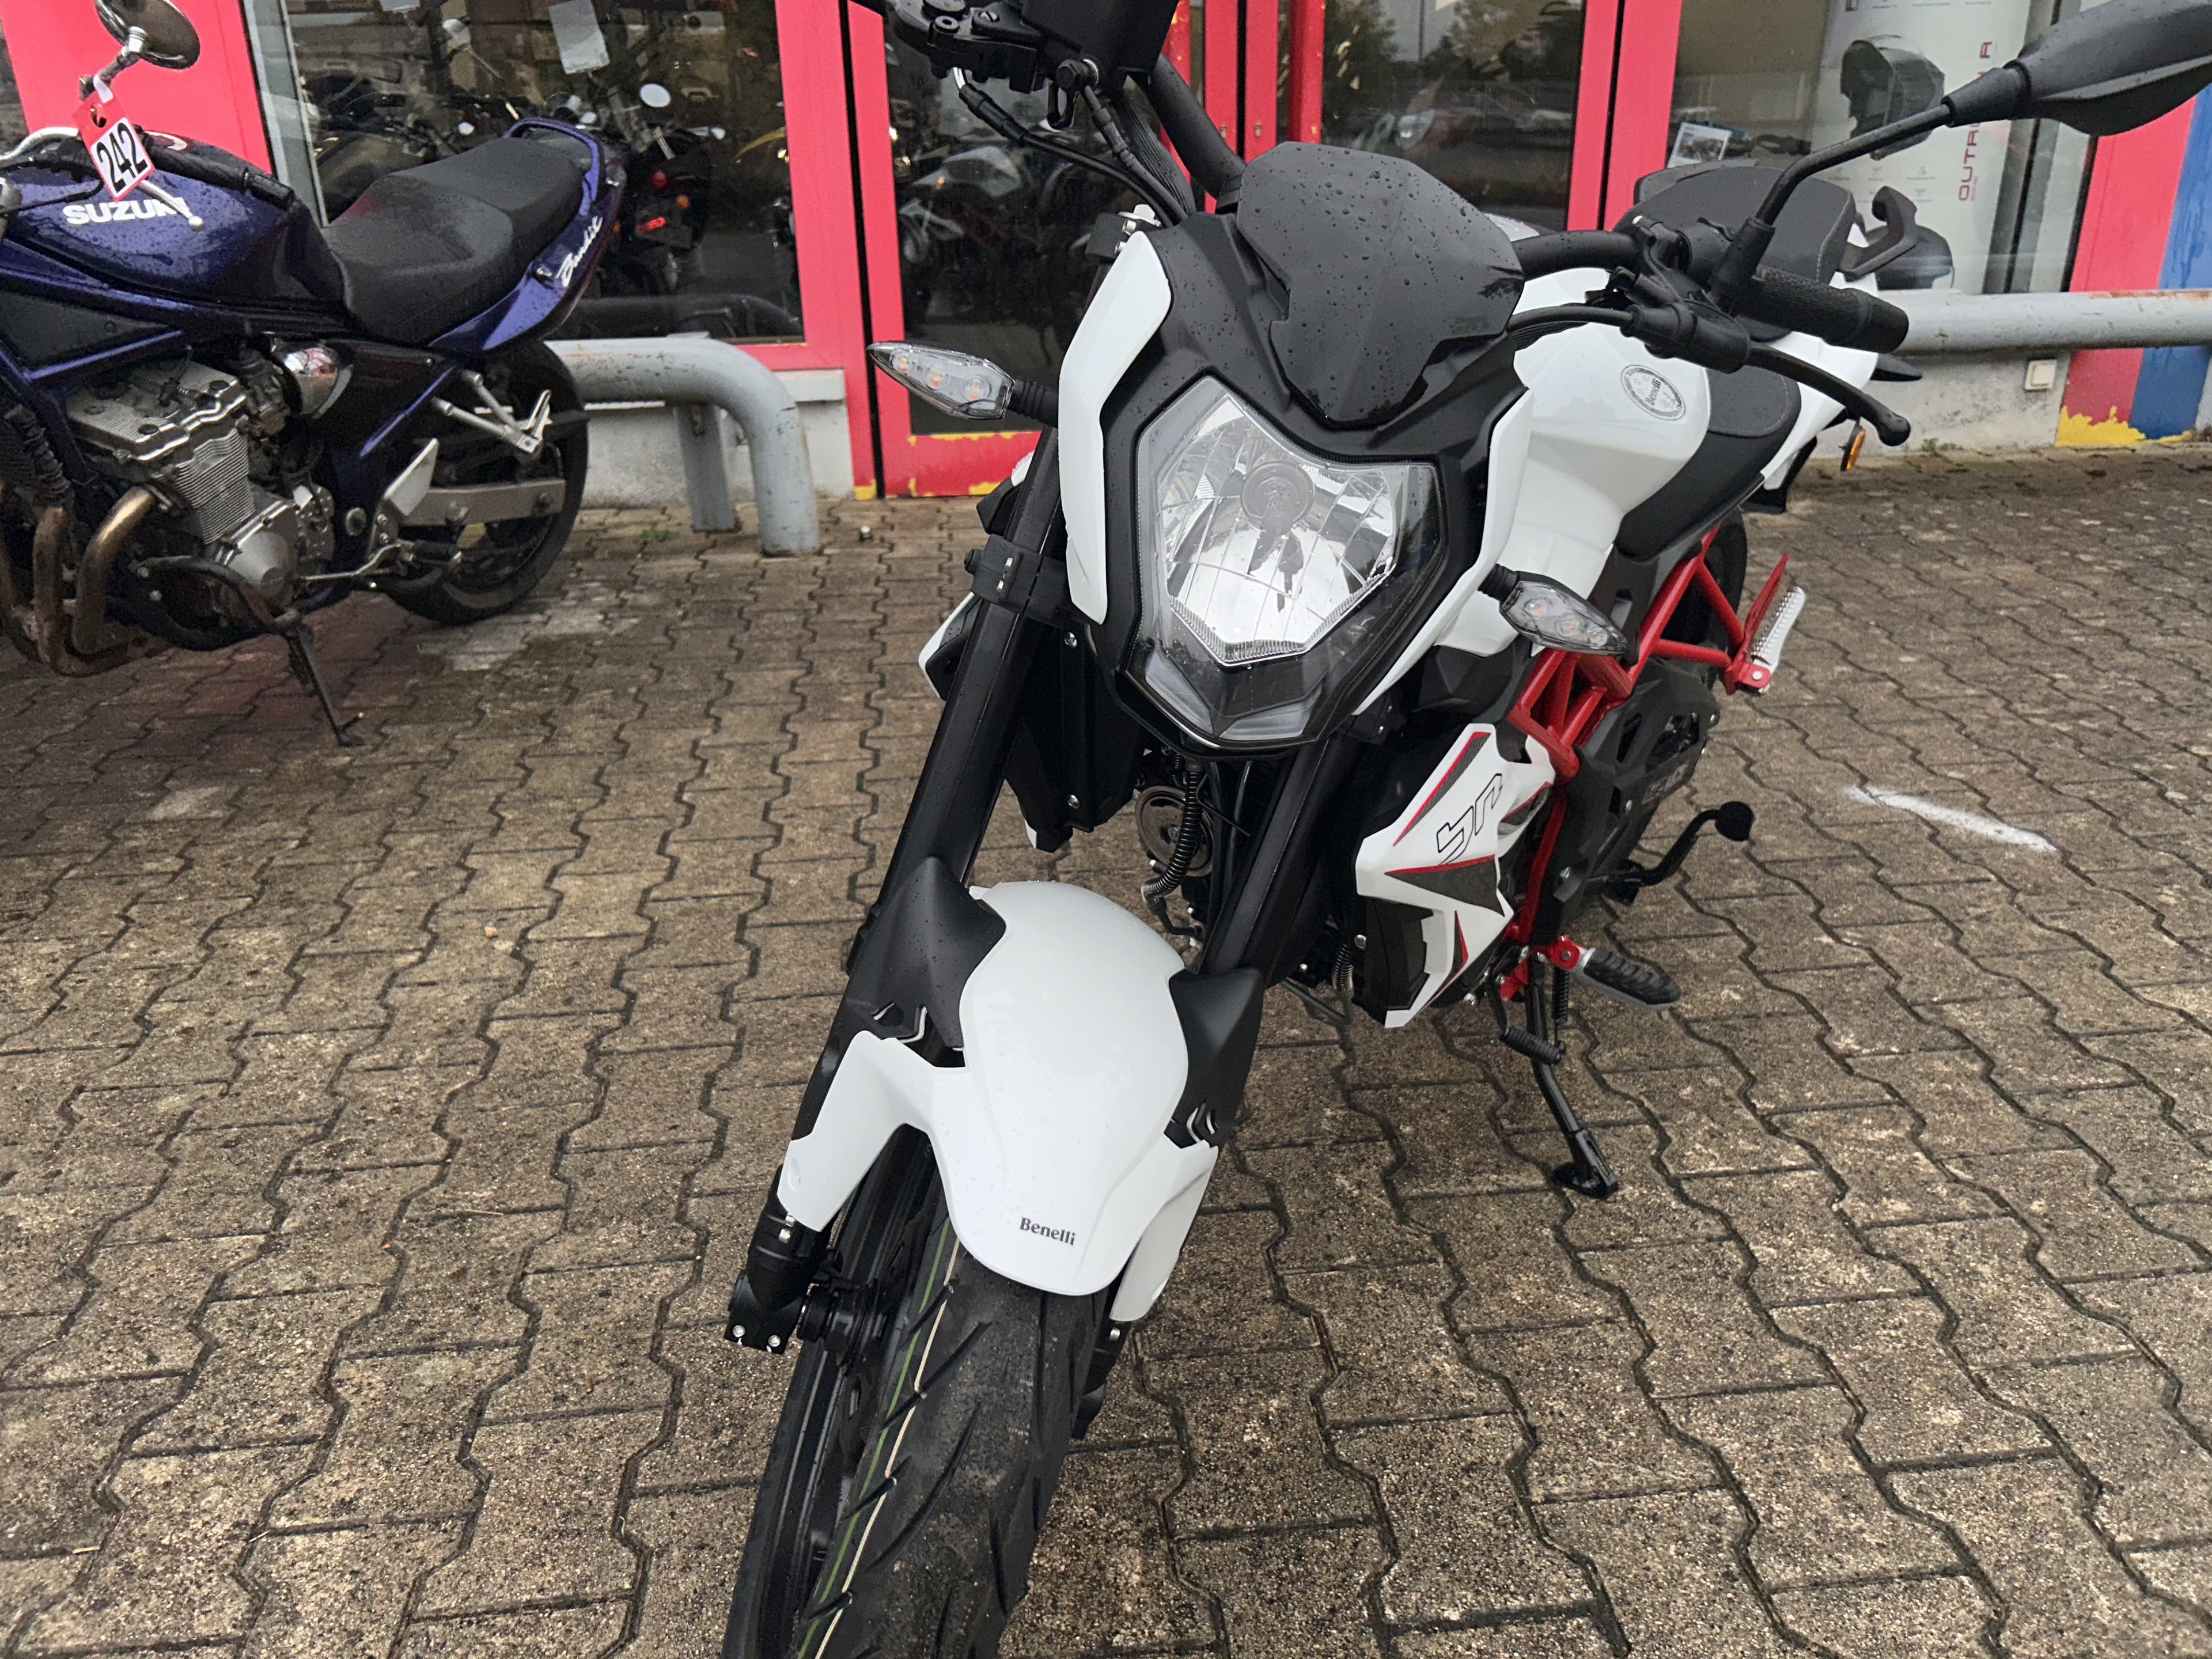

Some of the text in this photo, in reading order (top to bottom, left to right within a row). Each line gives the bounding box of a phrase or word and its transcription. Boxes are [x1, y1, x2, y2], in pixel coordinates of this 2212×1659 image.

[96, 122, 149, 194] 242
[1645, 377, 1661, 406] Benelli
[1019, 1216, 1076, 1246] Benelli
